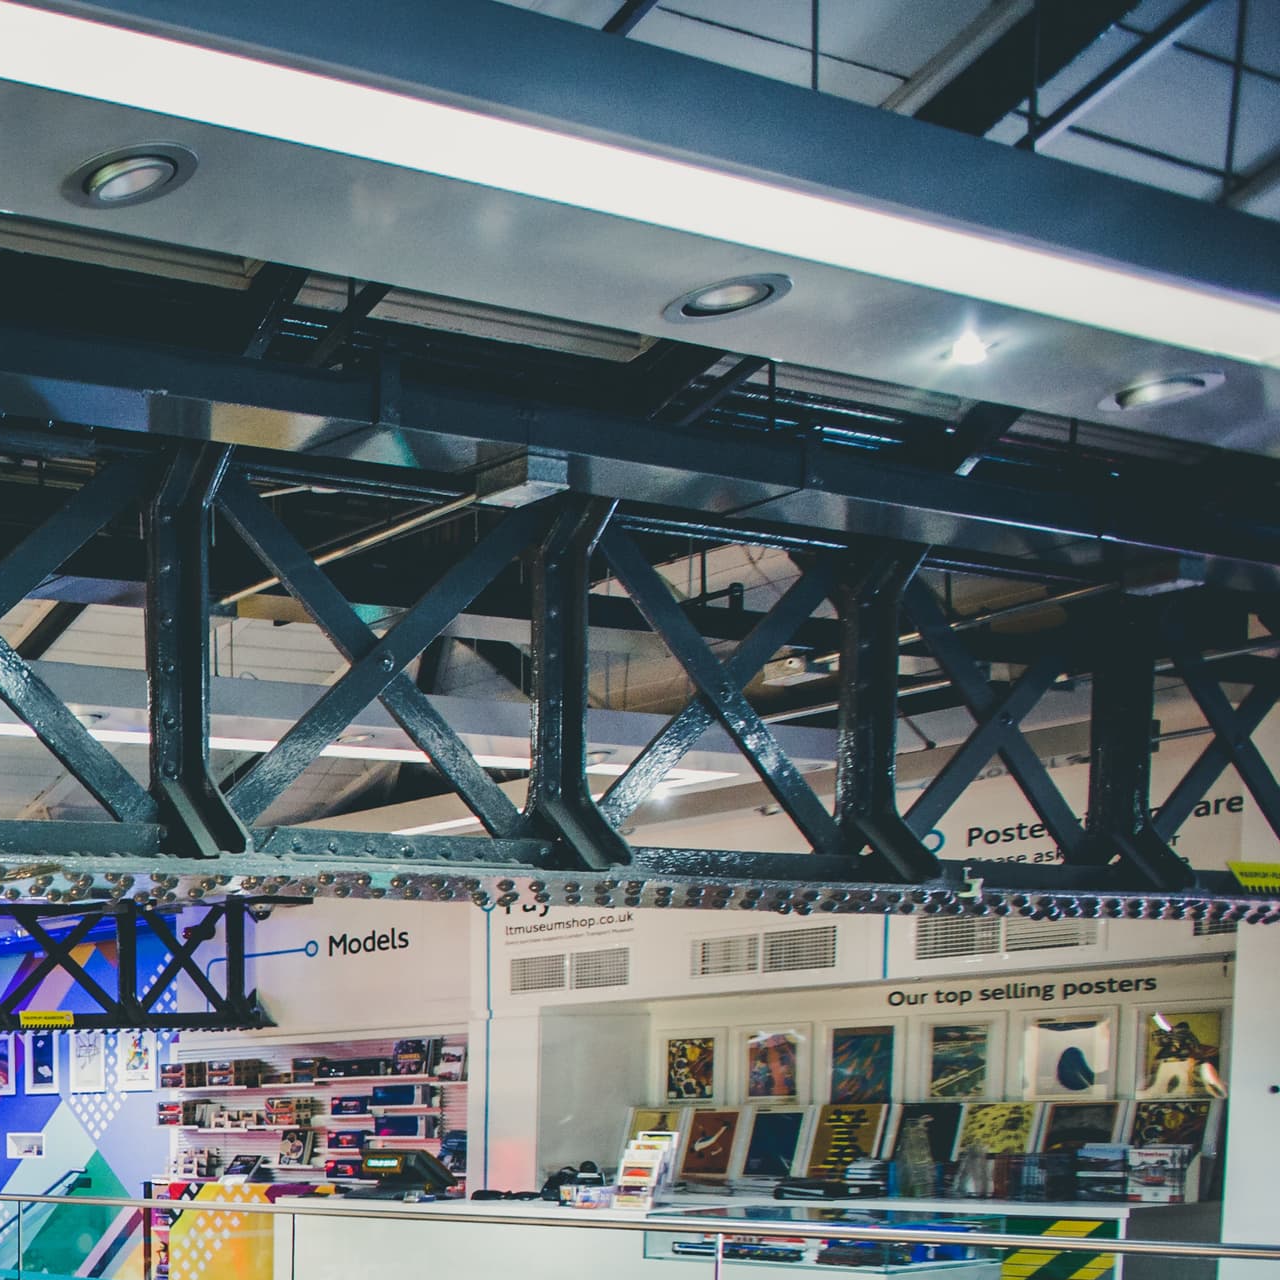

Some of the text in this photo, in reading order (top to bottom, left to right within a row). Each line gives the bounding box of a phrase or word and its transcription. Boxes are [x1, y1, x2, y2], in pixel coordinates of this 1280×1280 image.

[506, 912, 634, 936] ltmuseumshop.co.uk
[328, 927, 410, 957] Models
[888, 975, 1158, 1007] Our top selling posters
